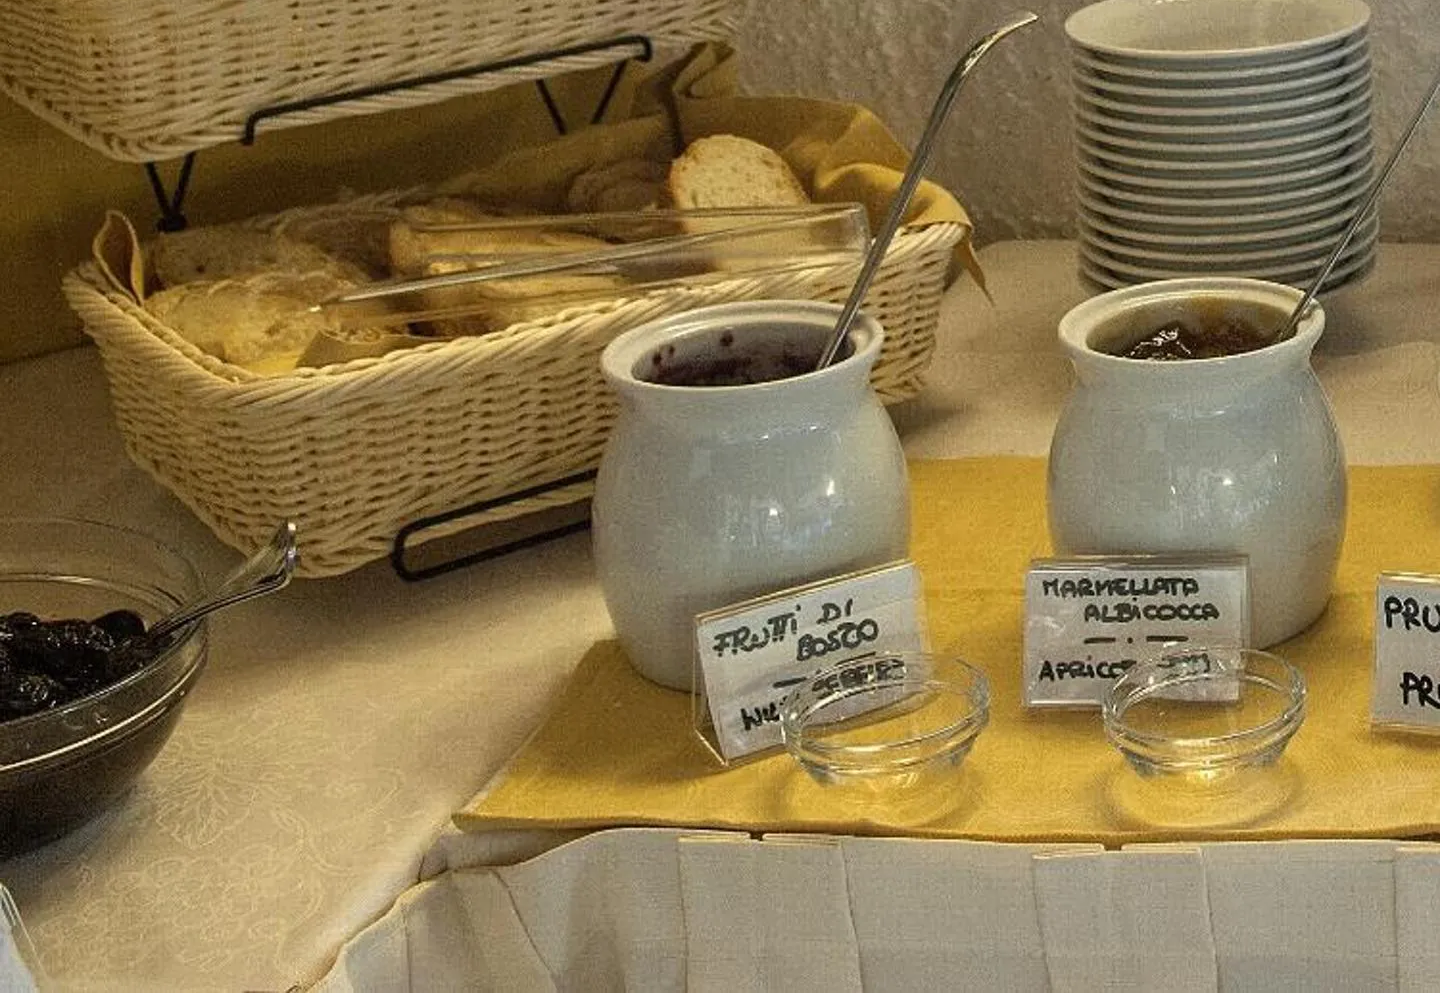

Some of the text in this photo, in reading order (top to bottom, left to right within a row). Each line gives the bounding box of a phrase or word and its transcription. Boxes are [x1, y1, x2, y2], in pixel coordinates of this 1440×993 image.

[1042, 577, 1200, 599] MARMELLATA
[815, 598, 854, 625] DI
[1084, 596, 1220, 623] ALBICOCCA
